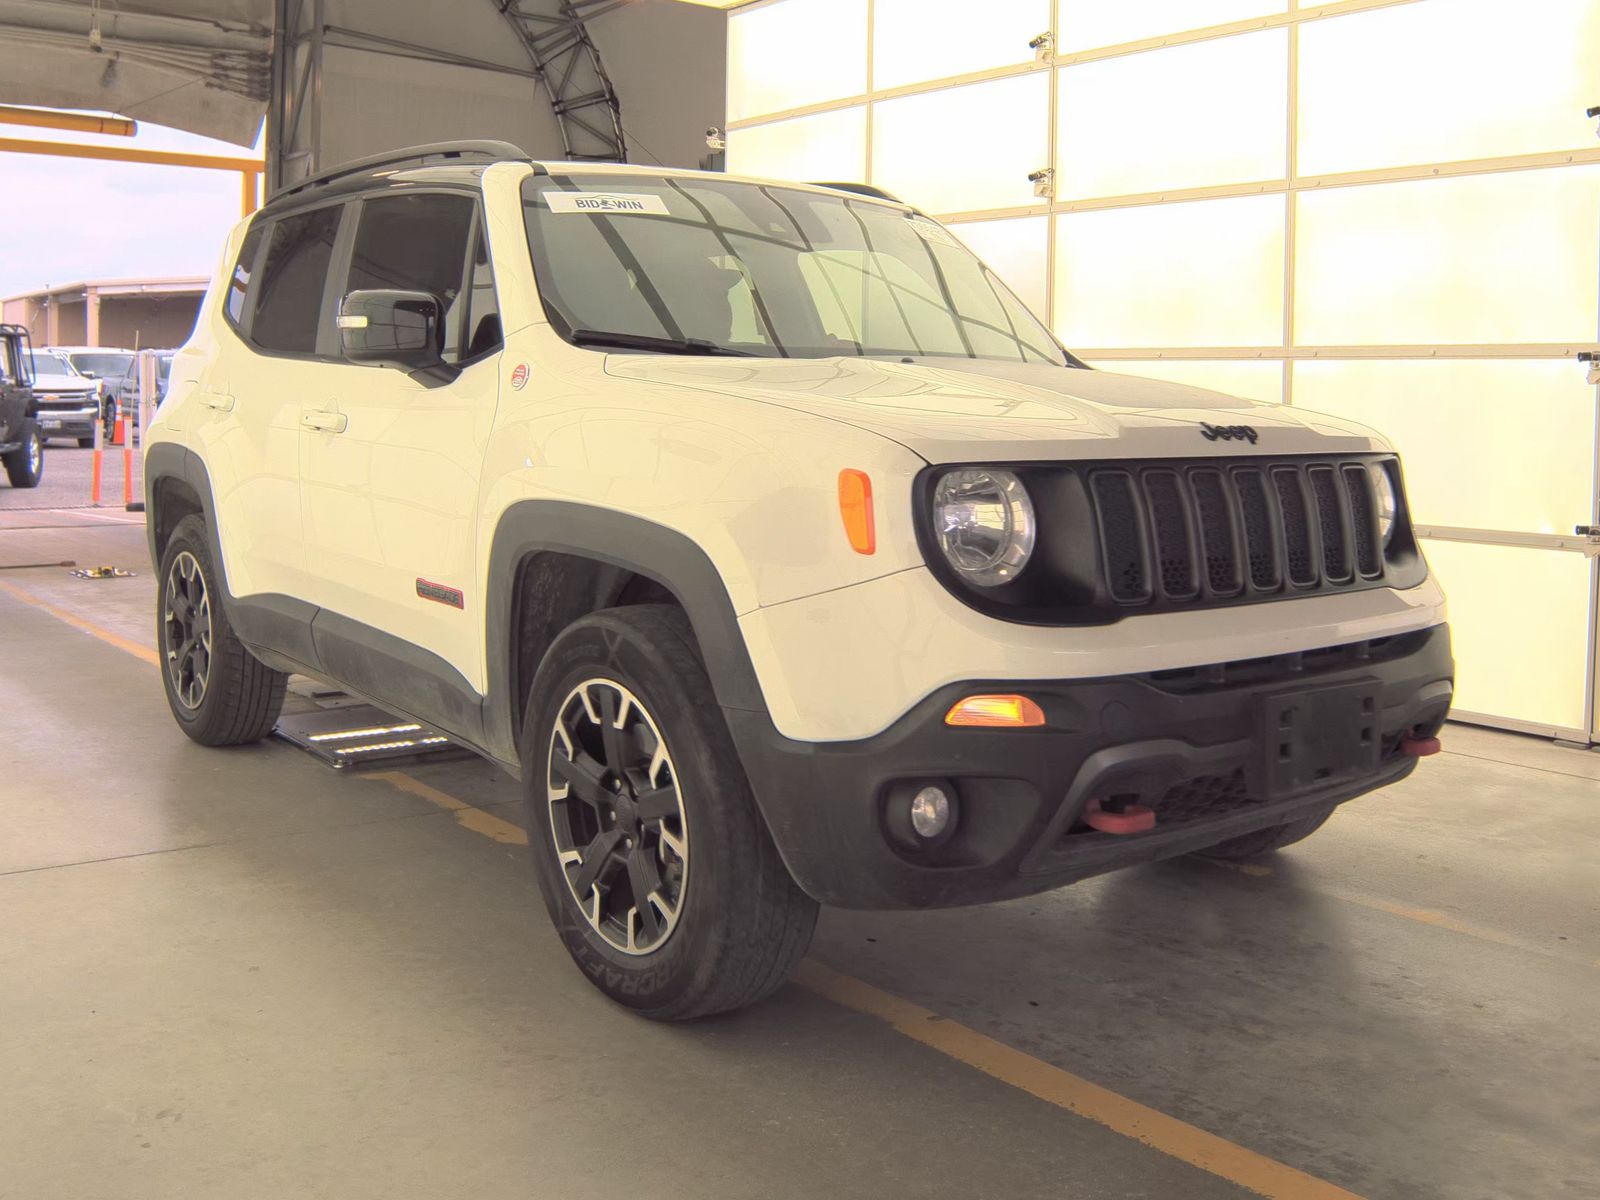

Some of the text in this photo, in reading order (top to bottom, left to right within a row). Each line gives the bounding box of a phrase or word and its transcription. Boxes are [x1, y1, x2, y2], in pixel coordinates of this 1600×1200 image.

[575, 199, 644, 210] BID WIN
[1199, 421, 1258, 445] Jeep
